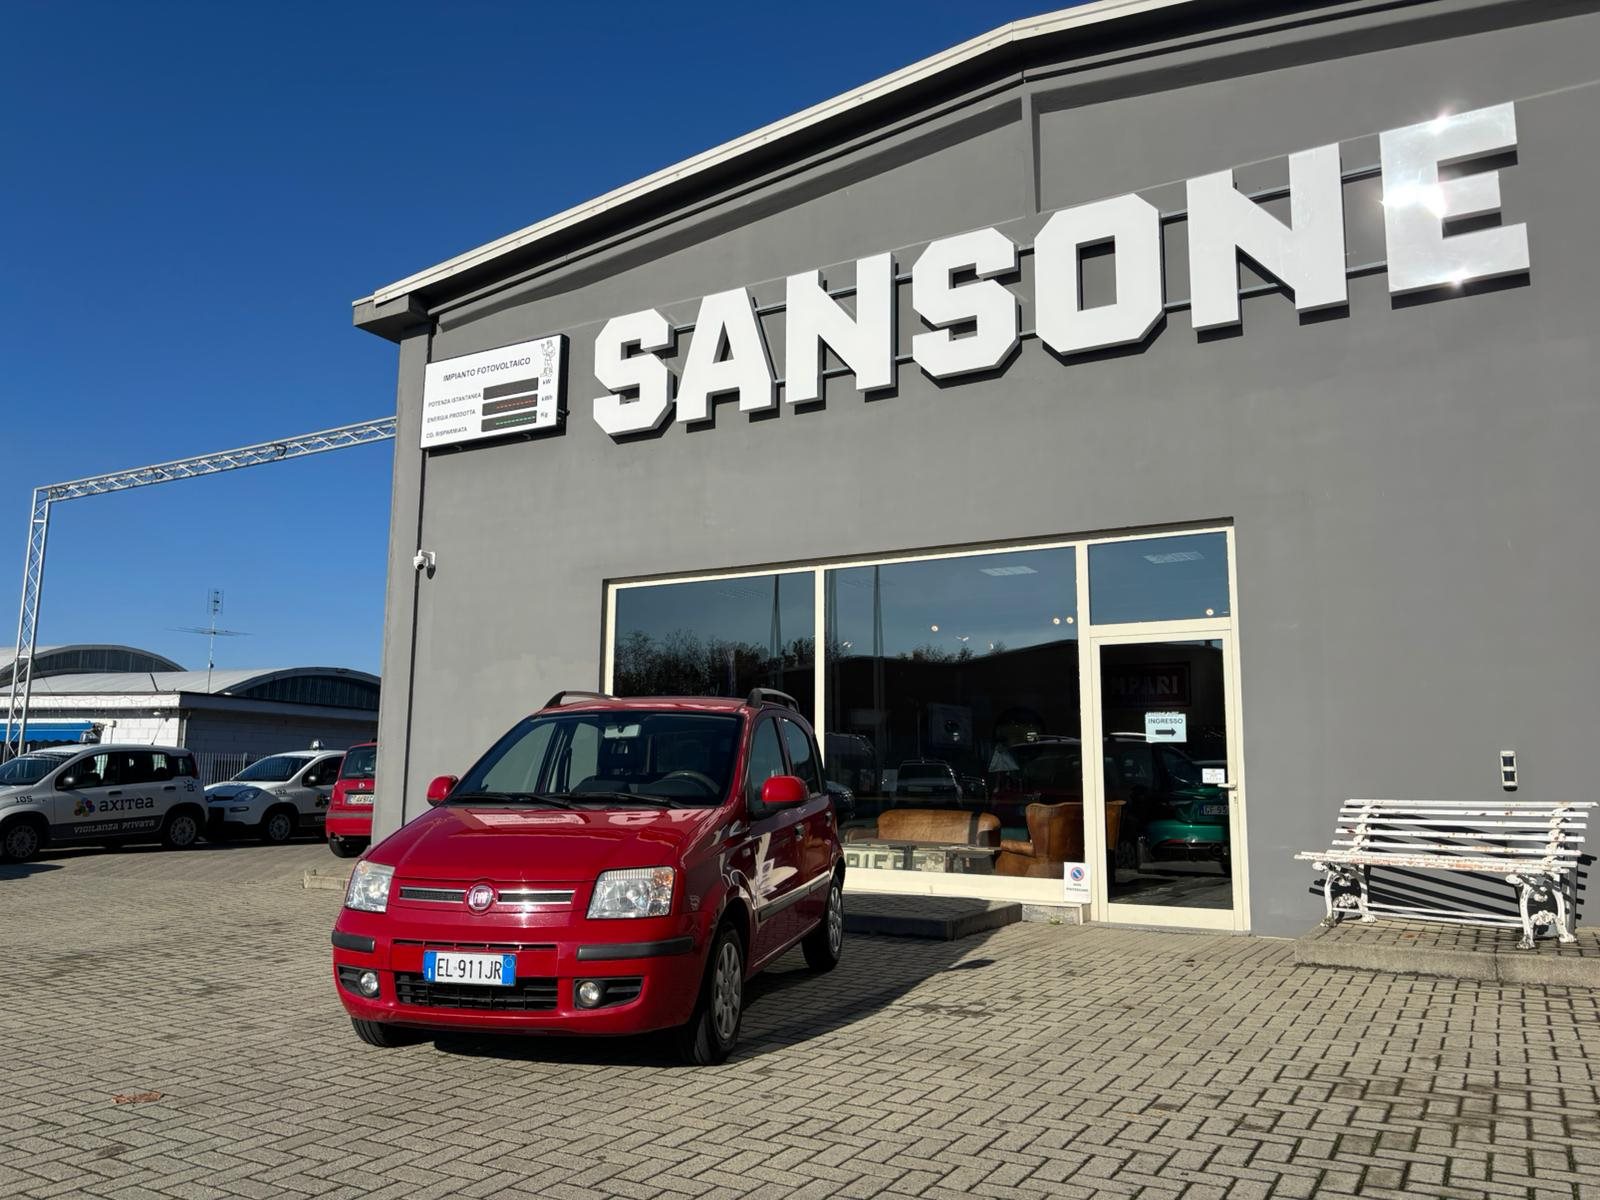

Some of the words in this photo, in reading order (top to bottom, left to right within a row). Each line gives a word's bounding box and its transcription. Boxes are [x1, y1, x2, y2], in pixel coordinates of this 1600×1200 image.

[593, 101, 1530, 436] SANSONE
[443, 368, 476, 382] IMPIANTO
[477, 357, 531, 375] FOTOVOLTAICO
[428, 396, 450, 407] POTENZA
[451, 392, 481, 404] ISTANTANEA
[427, 412, 449, 423] ENERGIA
[449, 409, 476, 421] PRODOTTA
